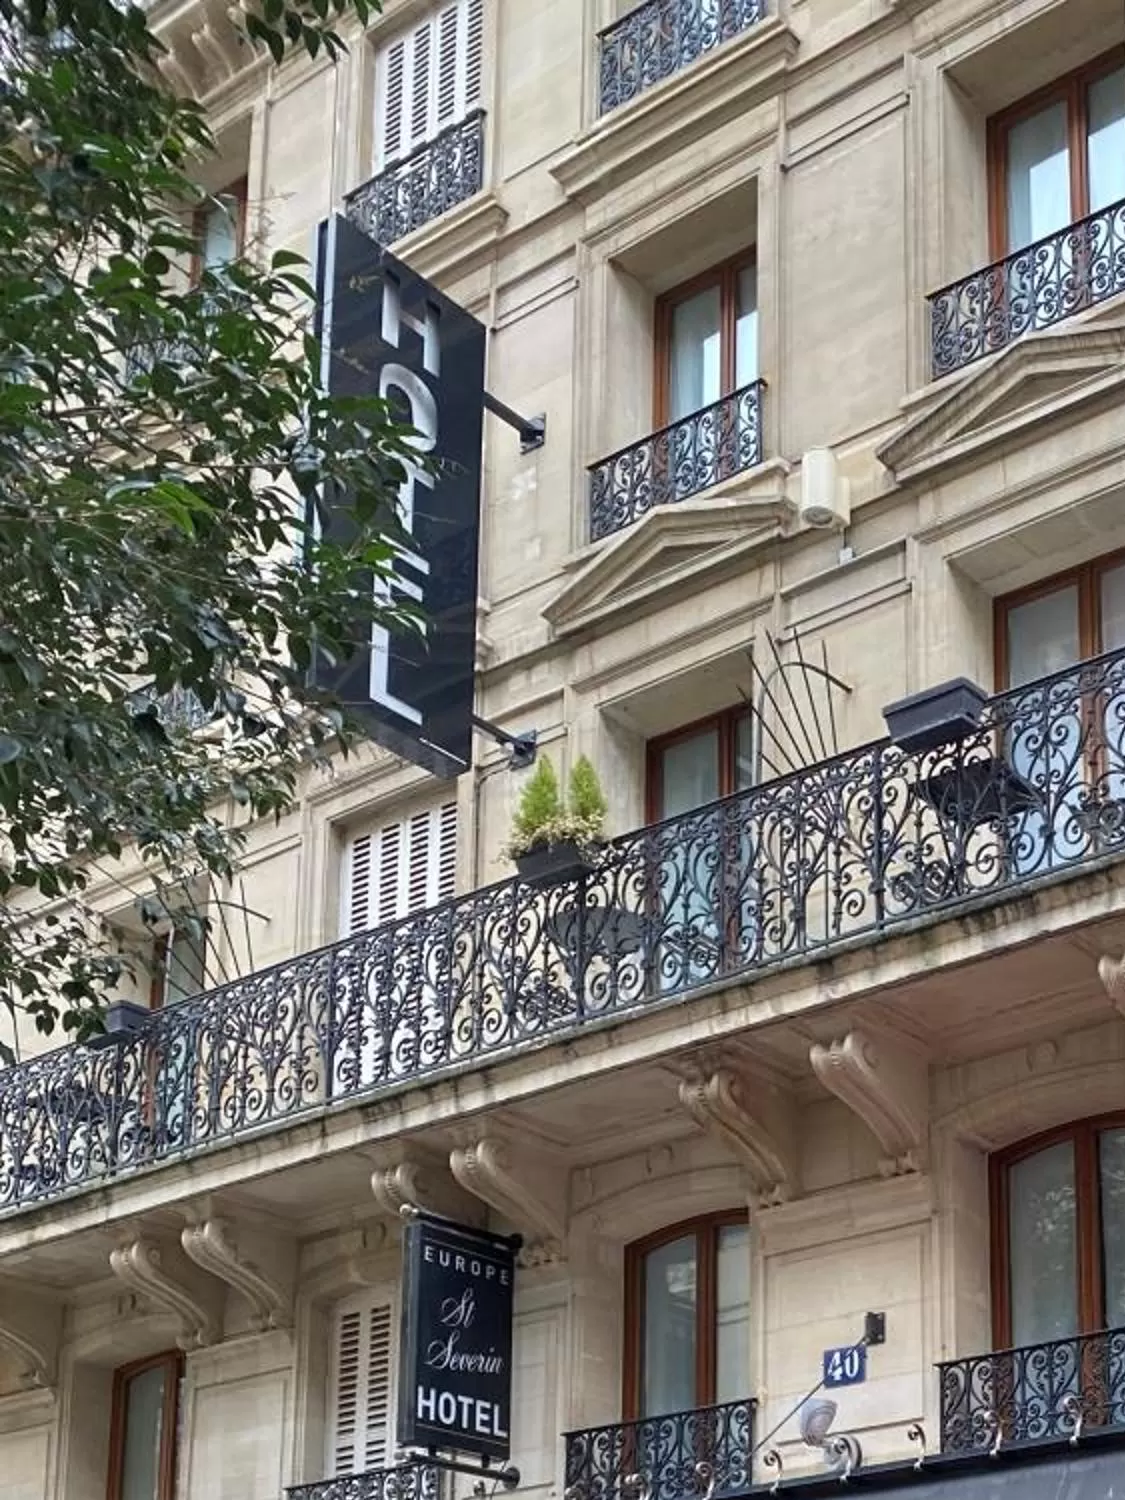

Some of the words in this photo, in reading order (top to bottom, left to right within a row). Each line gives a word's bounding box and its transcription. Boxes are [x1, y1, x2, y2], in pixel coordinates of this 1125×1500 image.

[369, 270, 441, 726] HOTEL
[424, 1245, 510, 1285] EUROPE
[441, 1287, 476, 1329] St
[425, 1330, 503, 1374] Severin
[827, 1349, 860, 1381] 40
[417, 1384, 508, 1438] HOTEL
